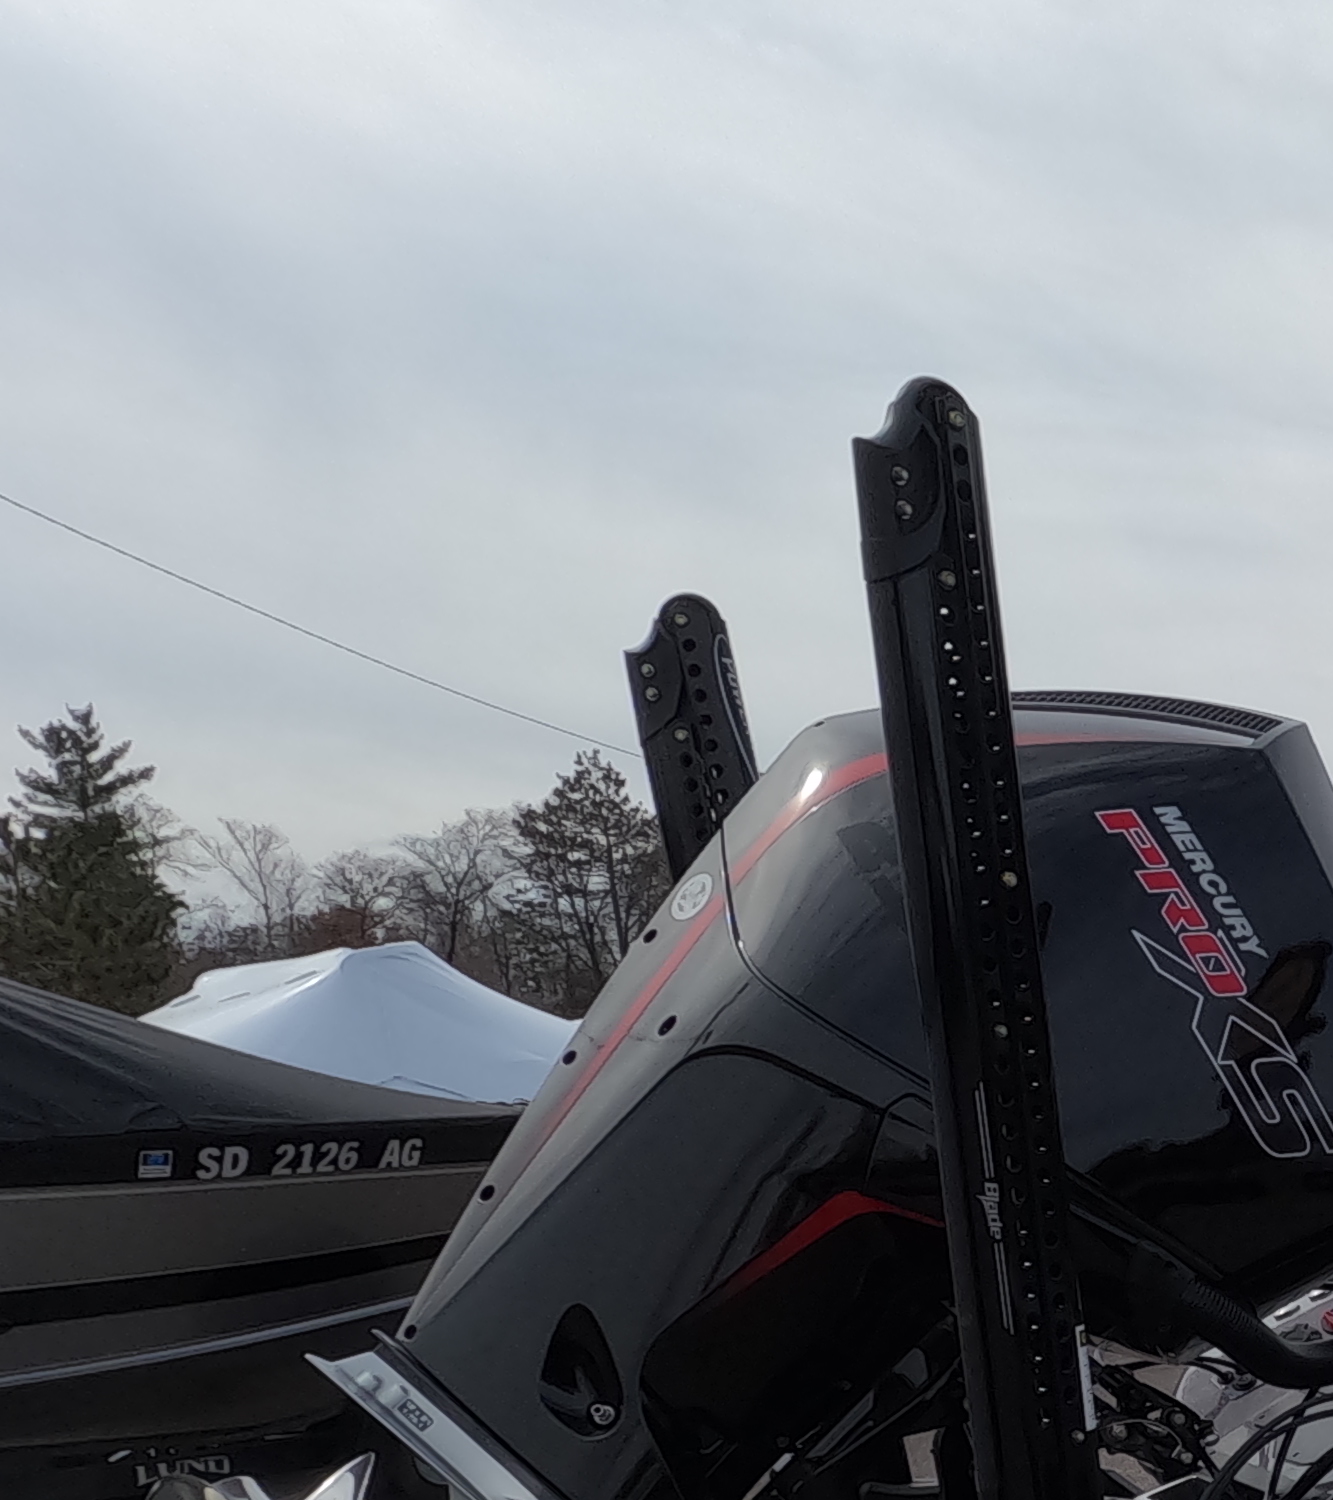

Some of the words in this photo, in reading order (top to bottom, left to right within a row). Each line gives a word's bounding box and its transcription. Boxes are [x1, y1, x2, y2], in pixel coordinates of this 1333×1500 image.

[1094, 808, 1248, 997] PRO
[1153, 805, 1269, 959] MERCURY
[195, 1146, 250, 1180] SD
[271, 1141, 360, 1177] 2126
[378, 1138, 424, 1169] AG
[975, 1181, 1003, 1241] Blade
[134, 1455, 231, 1487] LUND
